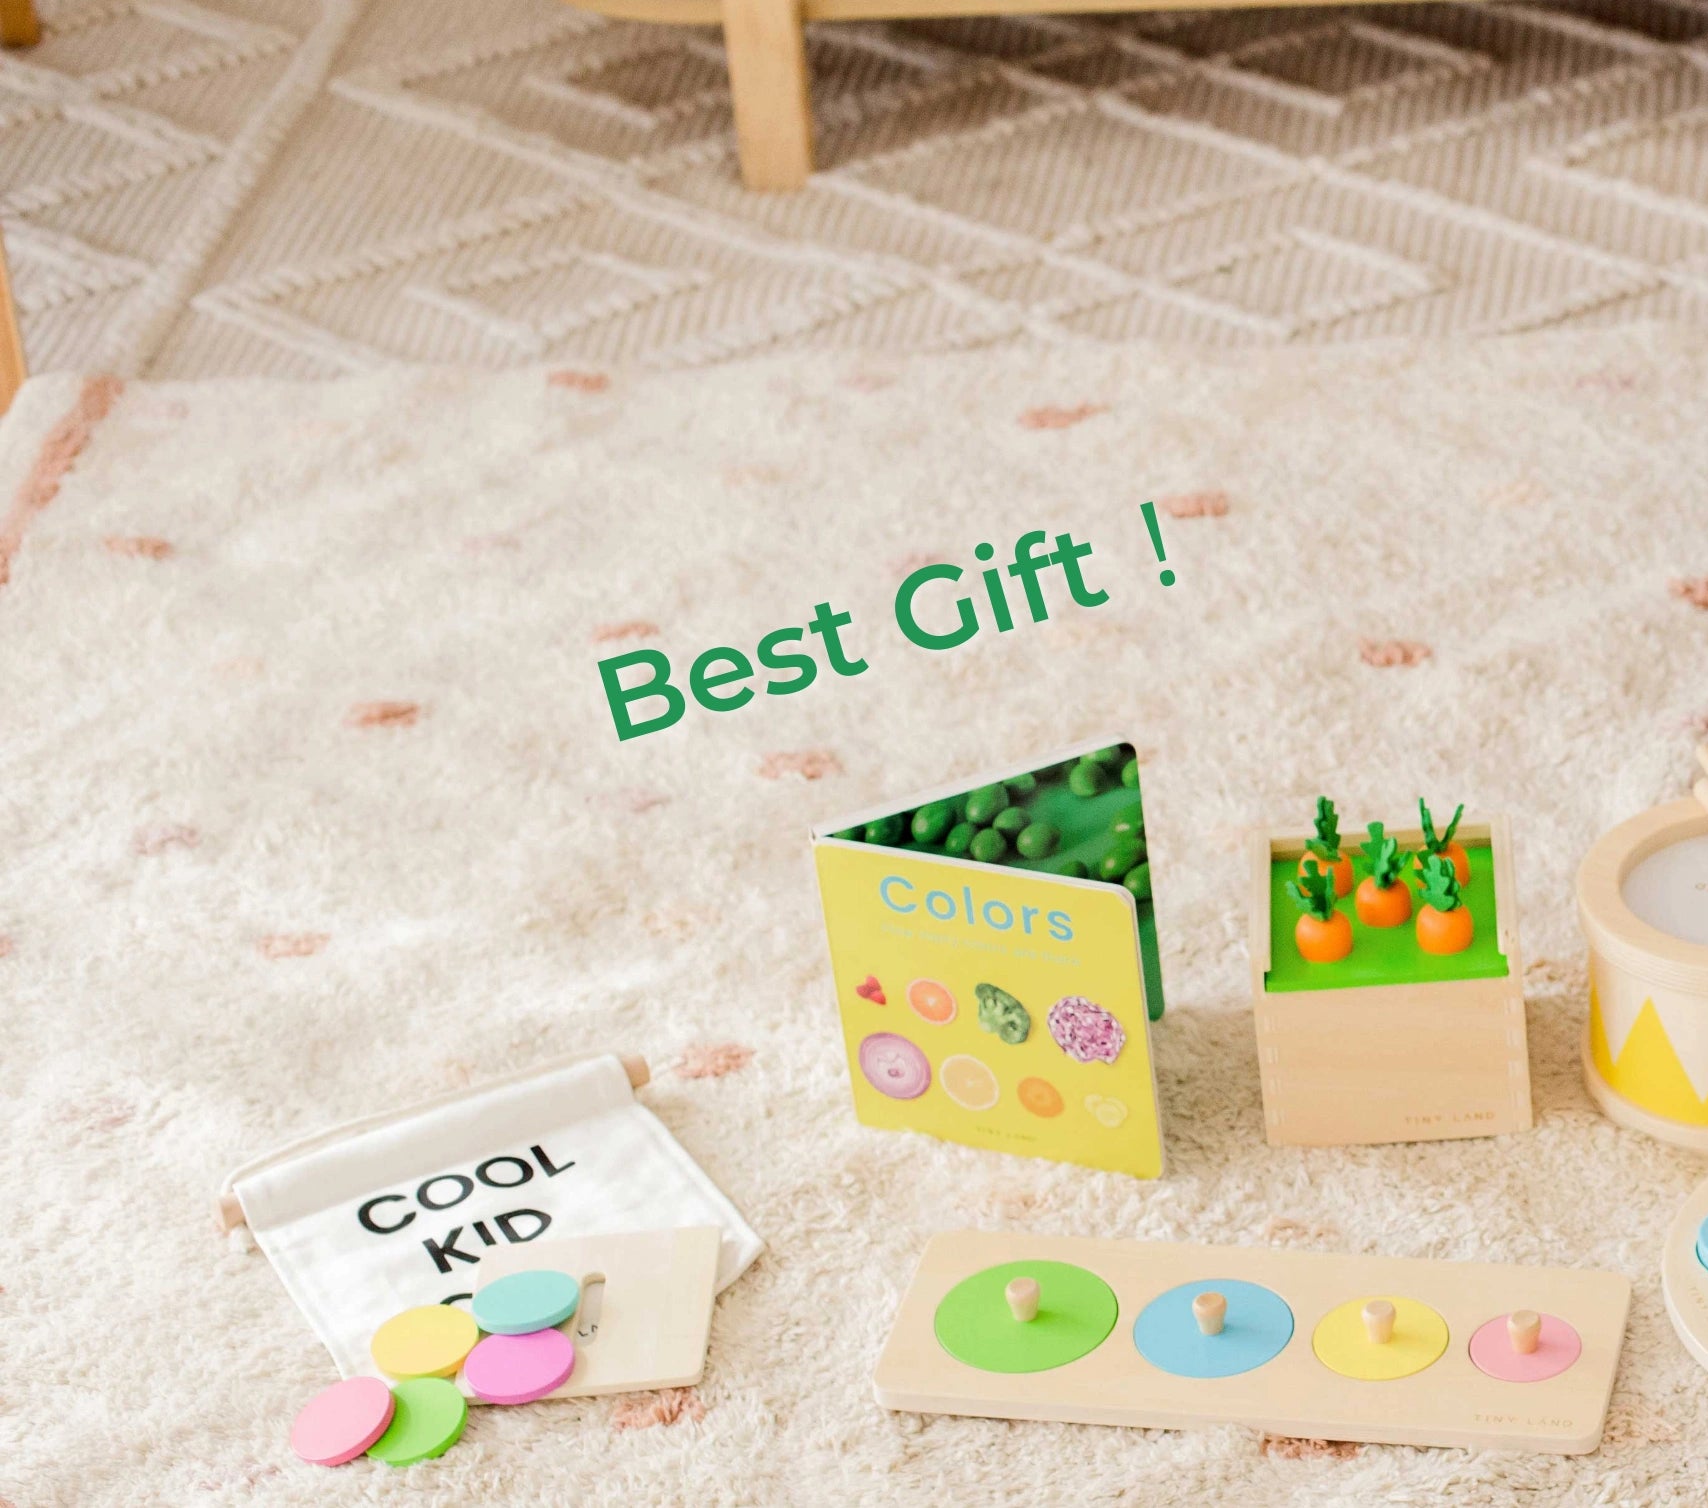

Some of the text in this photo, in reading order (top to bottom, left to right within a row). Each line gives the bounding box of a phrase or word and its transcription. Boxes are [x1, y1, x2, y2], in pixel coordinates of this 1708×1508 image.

[879, 876, 1075, 942] Colors
[357, 1145, 575, 1234] COOL
[422, 1208, 552, 1274] KID
